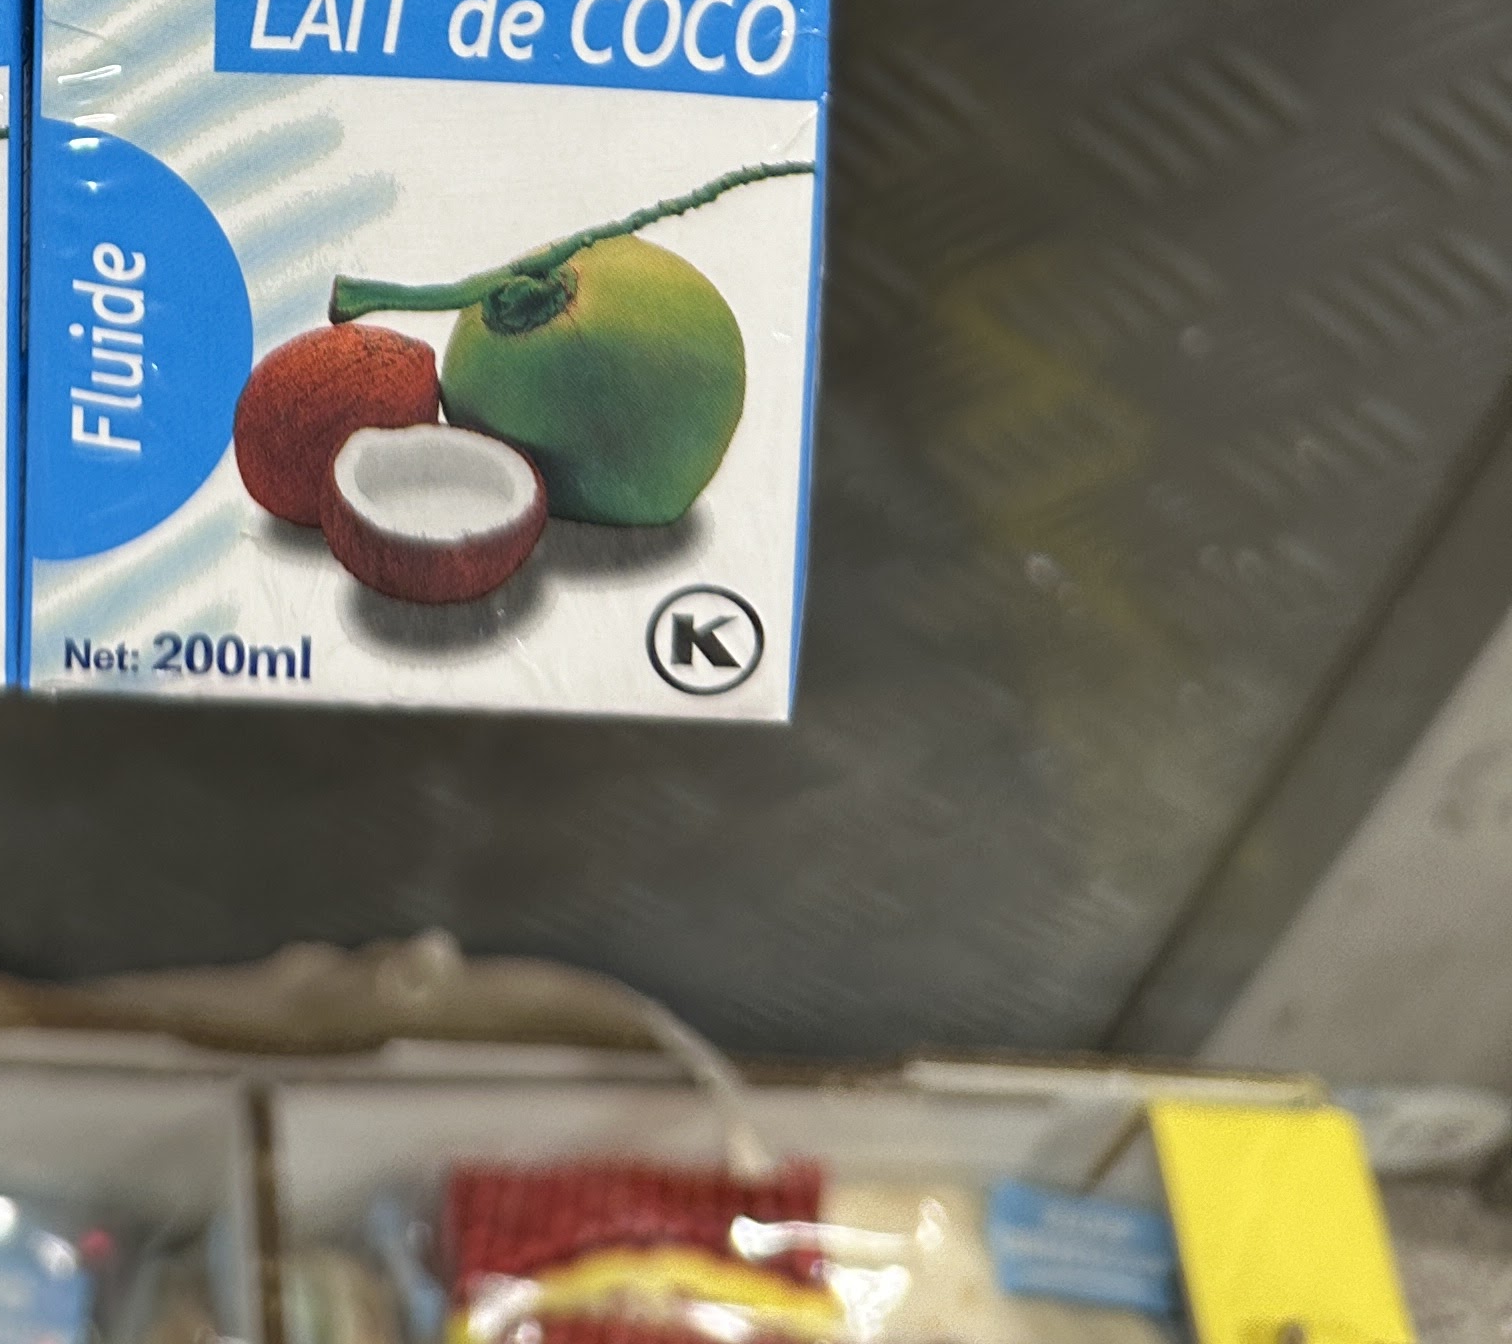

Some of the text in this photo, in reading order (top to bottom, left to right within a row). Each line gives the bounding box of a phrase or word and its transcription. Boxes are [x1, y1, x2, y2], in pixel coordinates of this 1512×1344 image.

[68, 241, 147, 454] Fluide
[63, 629, 312, 679] Net: 200ml
